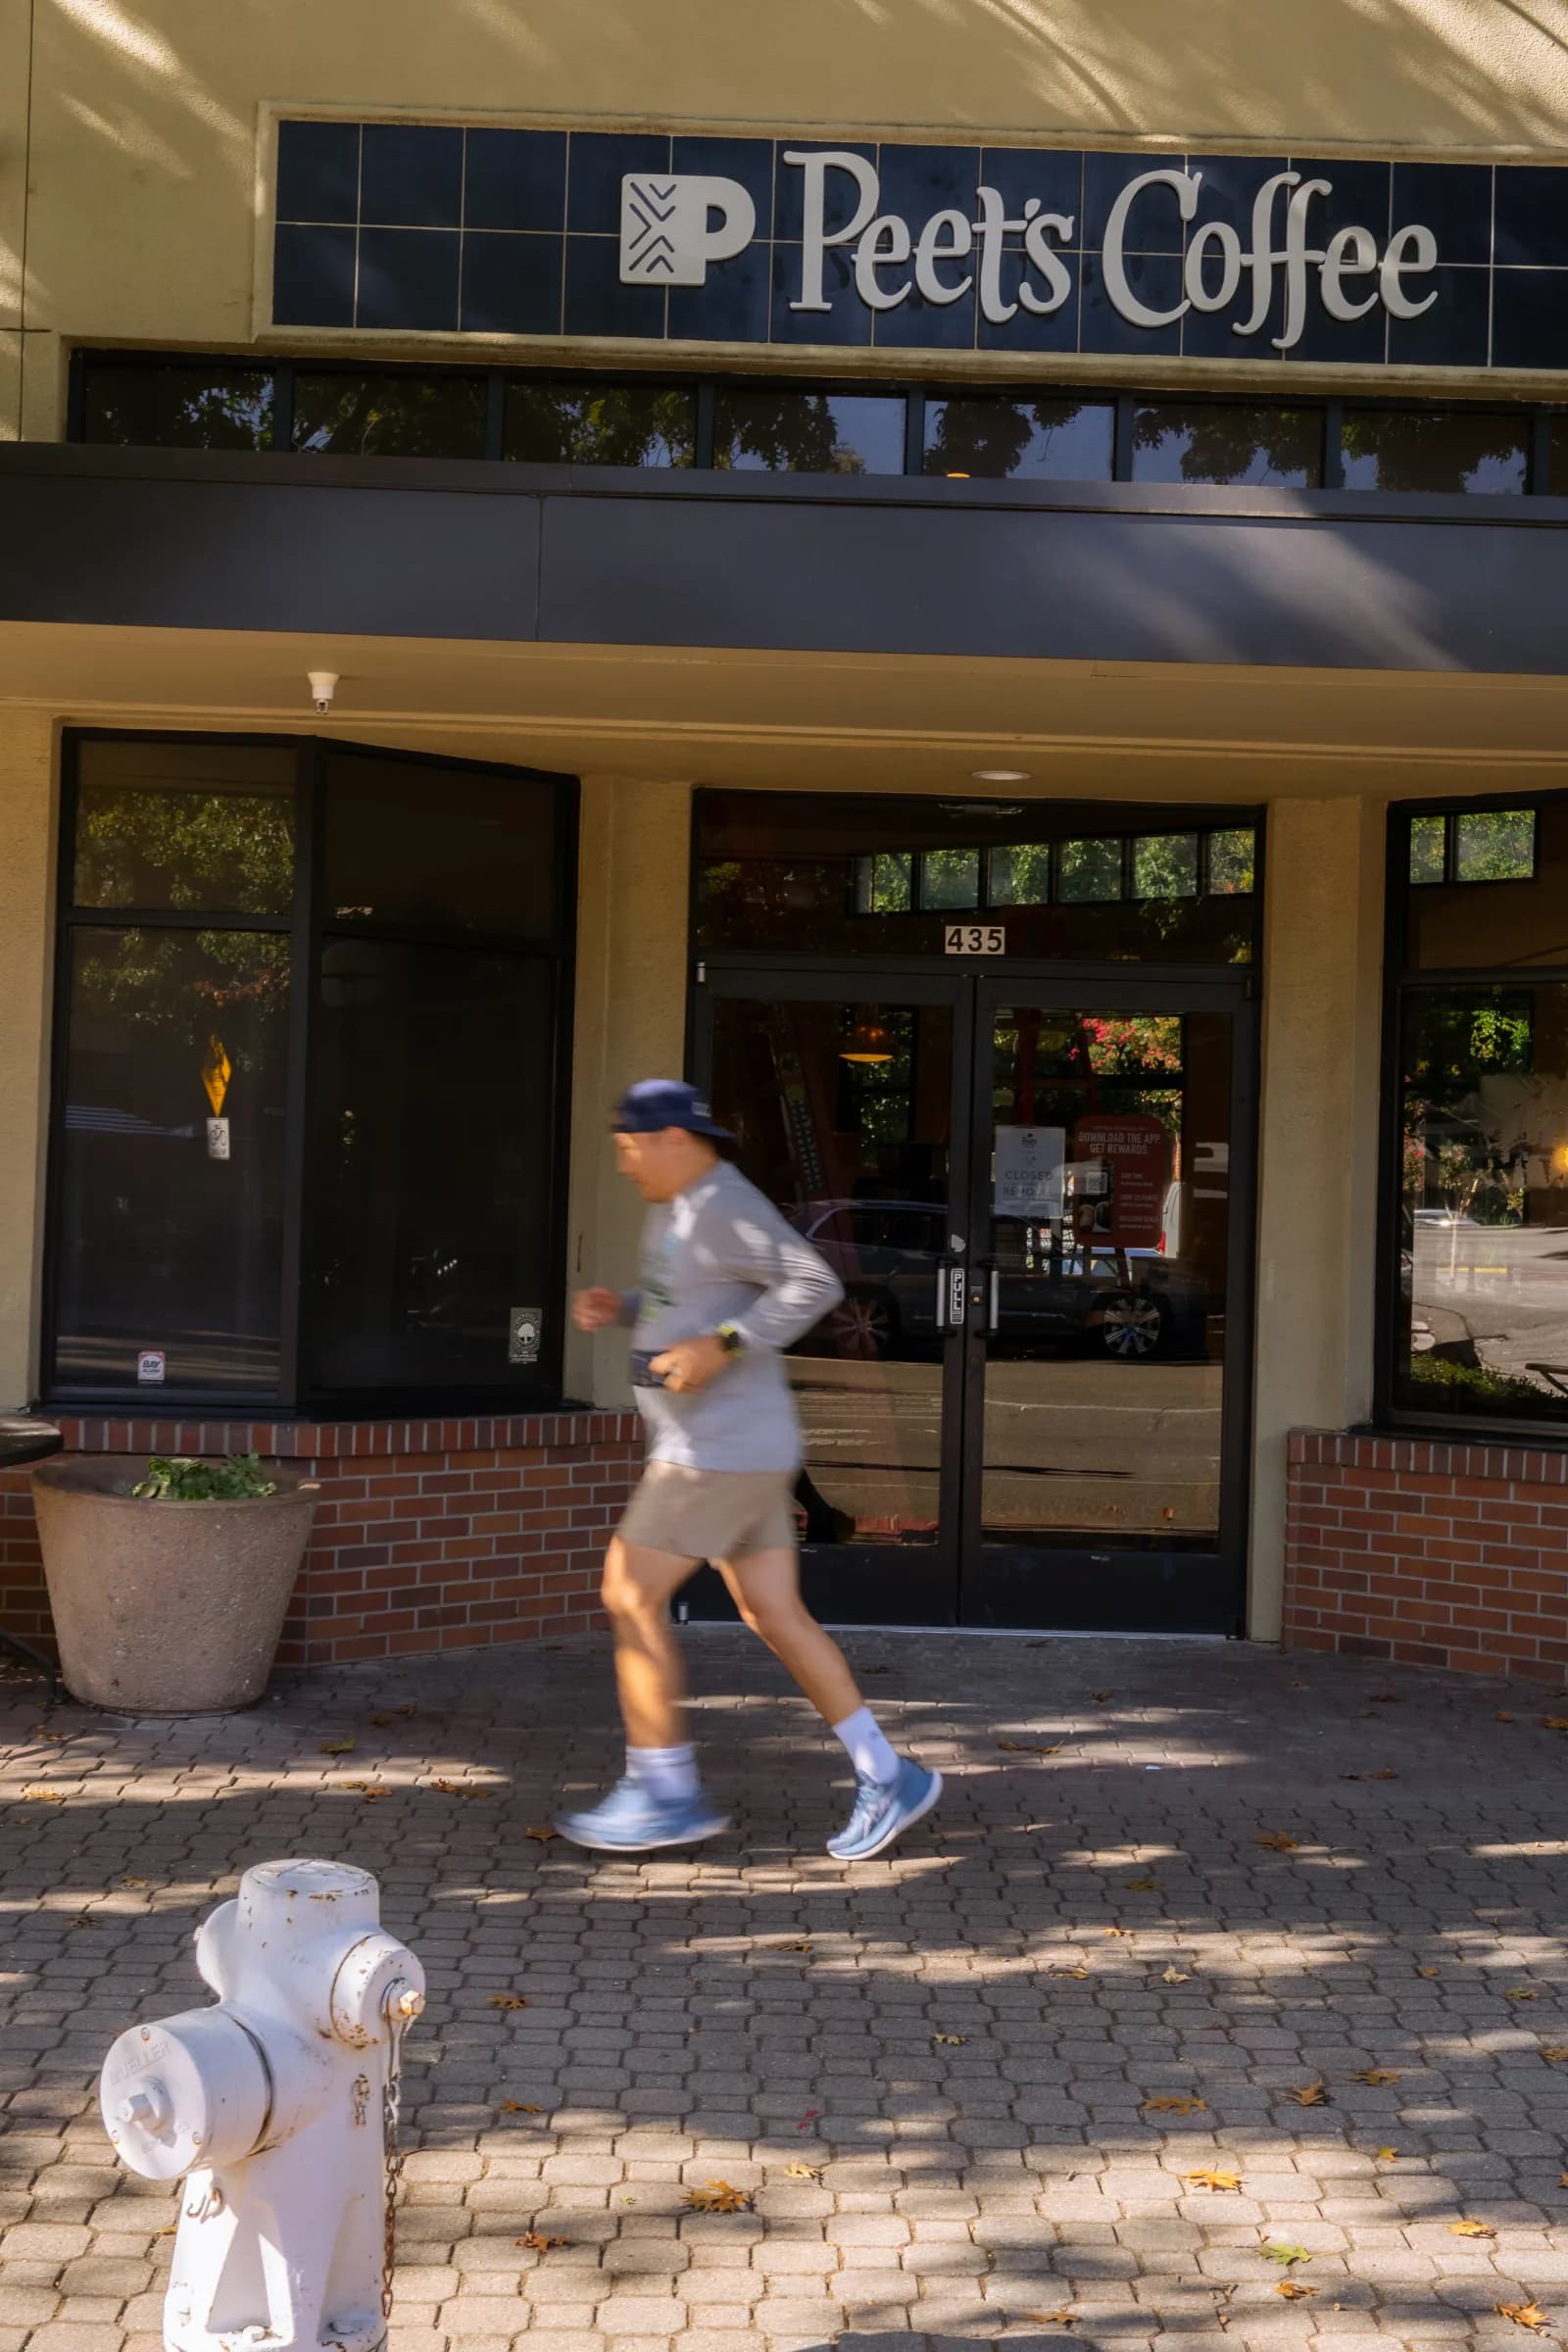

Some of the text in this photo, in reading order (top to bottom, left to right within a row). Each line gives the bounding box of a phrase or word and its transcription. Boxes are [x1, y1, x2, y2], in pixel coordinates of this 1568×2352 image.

[784, 151, 1438, 349] Peet's Coffee
[947, 927, 1003, 953] 435
[1078, 1131, 1124, 1144] DOWNLOAD
[1127, 1132, 1142, 1145] THE
[1090, 1143, 1105, 1153] GET
[953, 1273, 962, 1311] PULL
